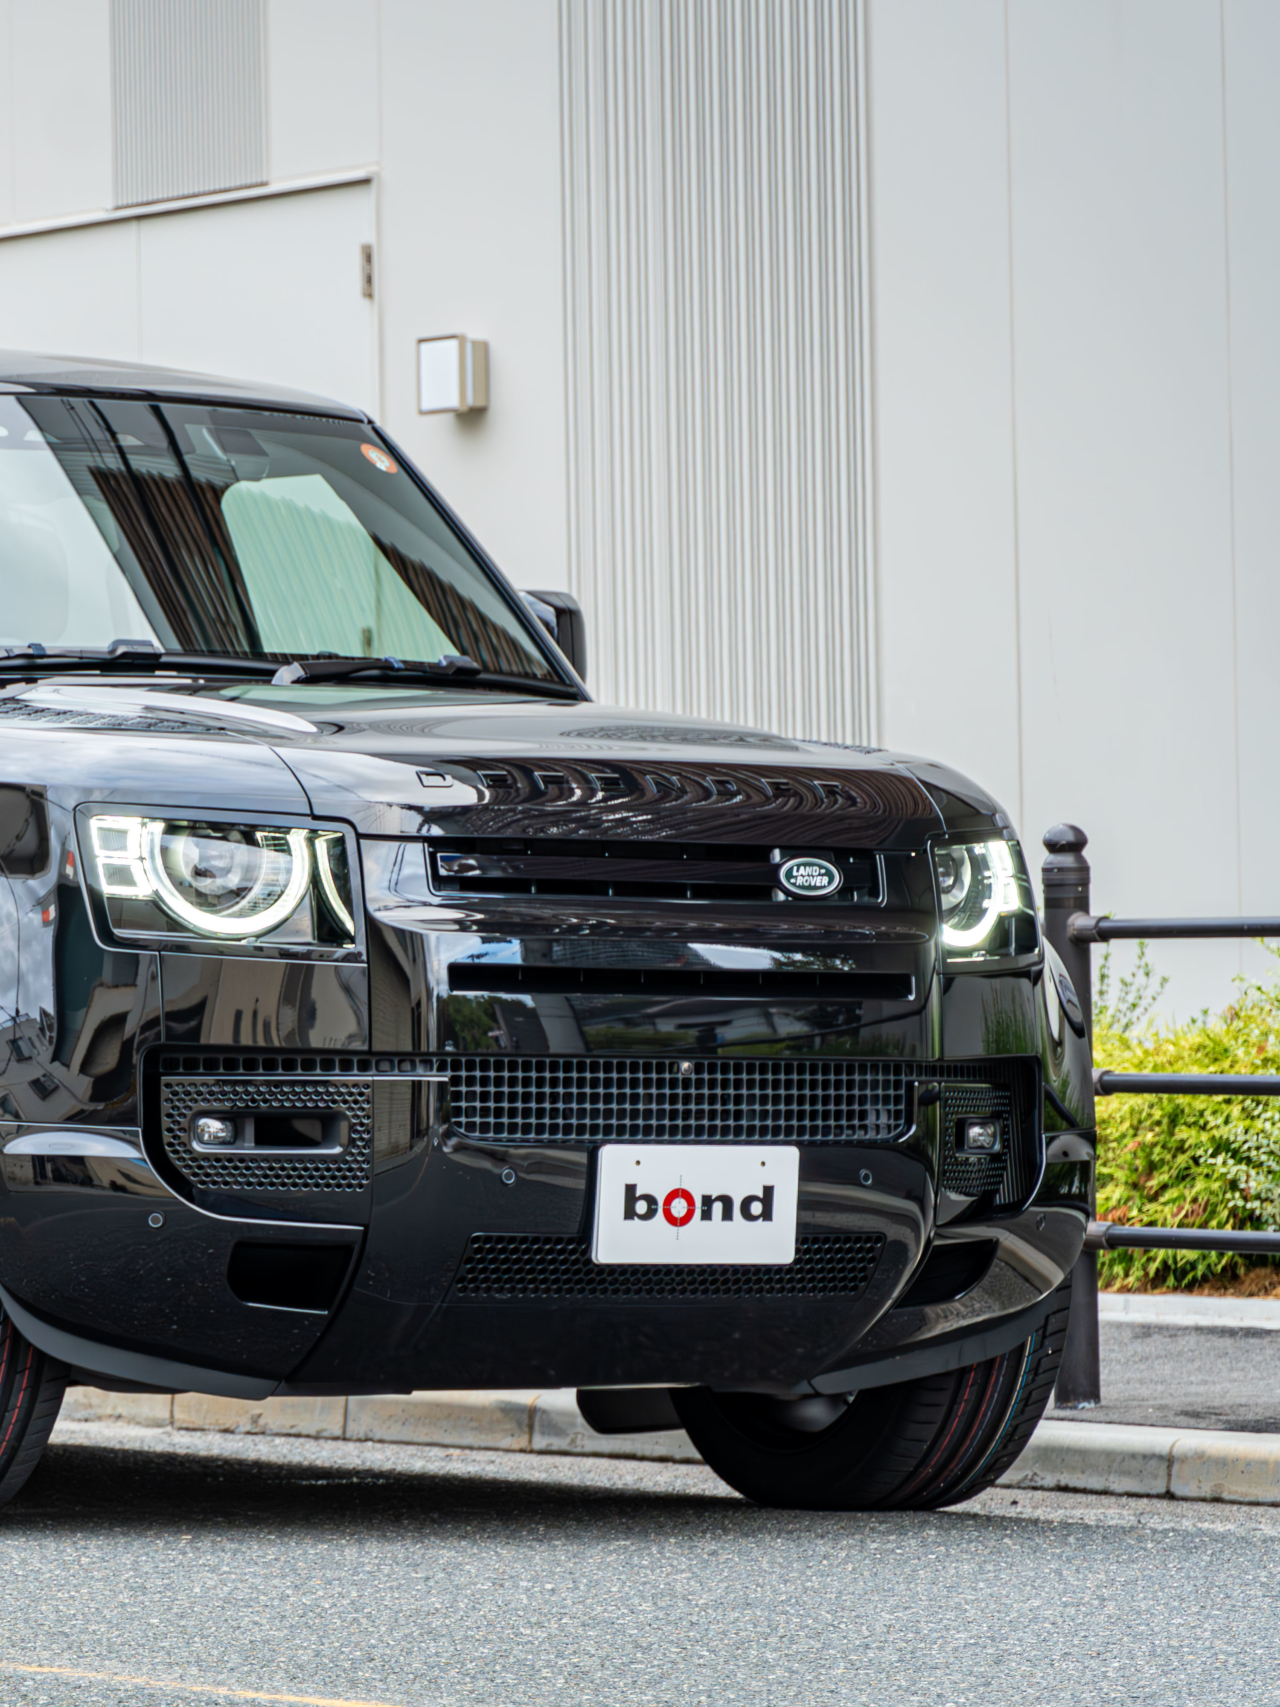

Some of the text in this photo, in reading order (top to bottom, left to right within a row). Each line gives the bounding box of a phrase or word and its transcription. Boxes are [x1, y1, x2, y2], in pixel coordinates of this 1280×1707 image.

[416, 771, 859, 802] DEFENDER
[792, 866, 819, 876] LAND
[795, 876, 829, 886] ROVER
[623, 1183, 775, 1228] bond
